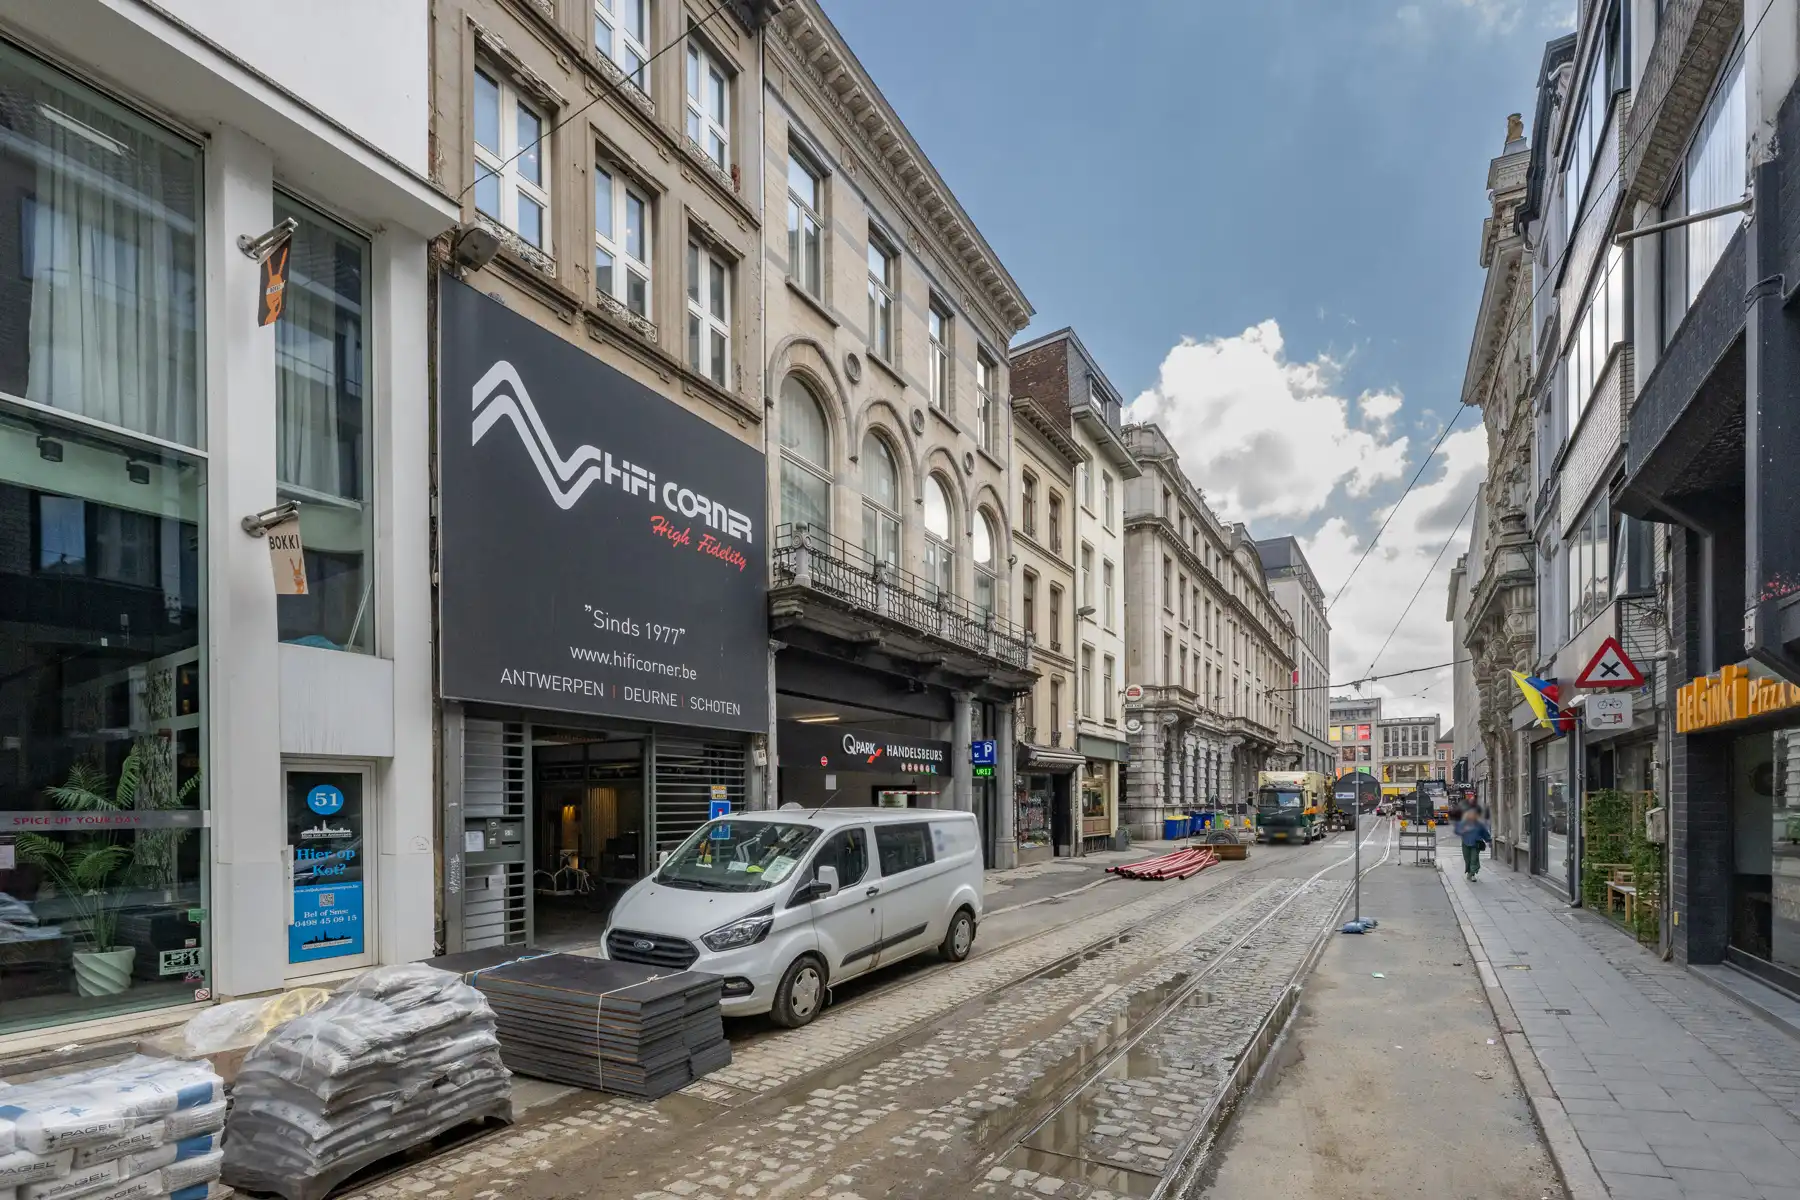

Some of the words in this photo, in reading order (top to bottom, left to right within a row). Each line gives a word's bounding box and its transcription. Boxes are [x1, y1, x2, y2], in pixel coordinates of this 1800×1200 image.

[663, 482, 752, 543] CORNER
[269, 535, 300, 550] BOKKI
[651, 515, 691, 547] High
[698, 533, 747, 571] Fidelity
[570, 646, 697, 680] www.hificorner.be
[500, 668, 604, 697] ANTWERPEN
[624, 687, 678, 707] DEURNE
[690, 696, 741, 716] SCHOTEN
[886, 744, 943, 762] HANDELSBEURS
[976, 768, 992, 776] VRIJ
[314, 792, 339, 807] 51
[13, 816, 50, 826] SPICE
[54, 817, 72, 825] UP
[77, 816, 111, 825] YOUR
[115, 816, 141, 825] DAY
[296, 848, 333, 861] Hier
[337, 850, 356, 860] op
[312, 863, 346, 877] Kot?
[295, 919, 317, 927] 0498
[61, 1123, 117, 1139] PAGEL
[95, 1133, 151, 1154] PAGEL
[50, 1172, 111, 1196] PAGEL
[104, 1184, 148, 1200] AGEL
